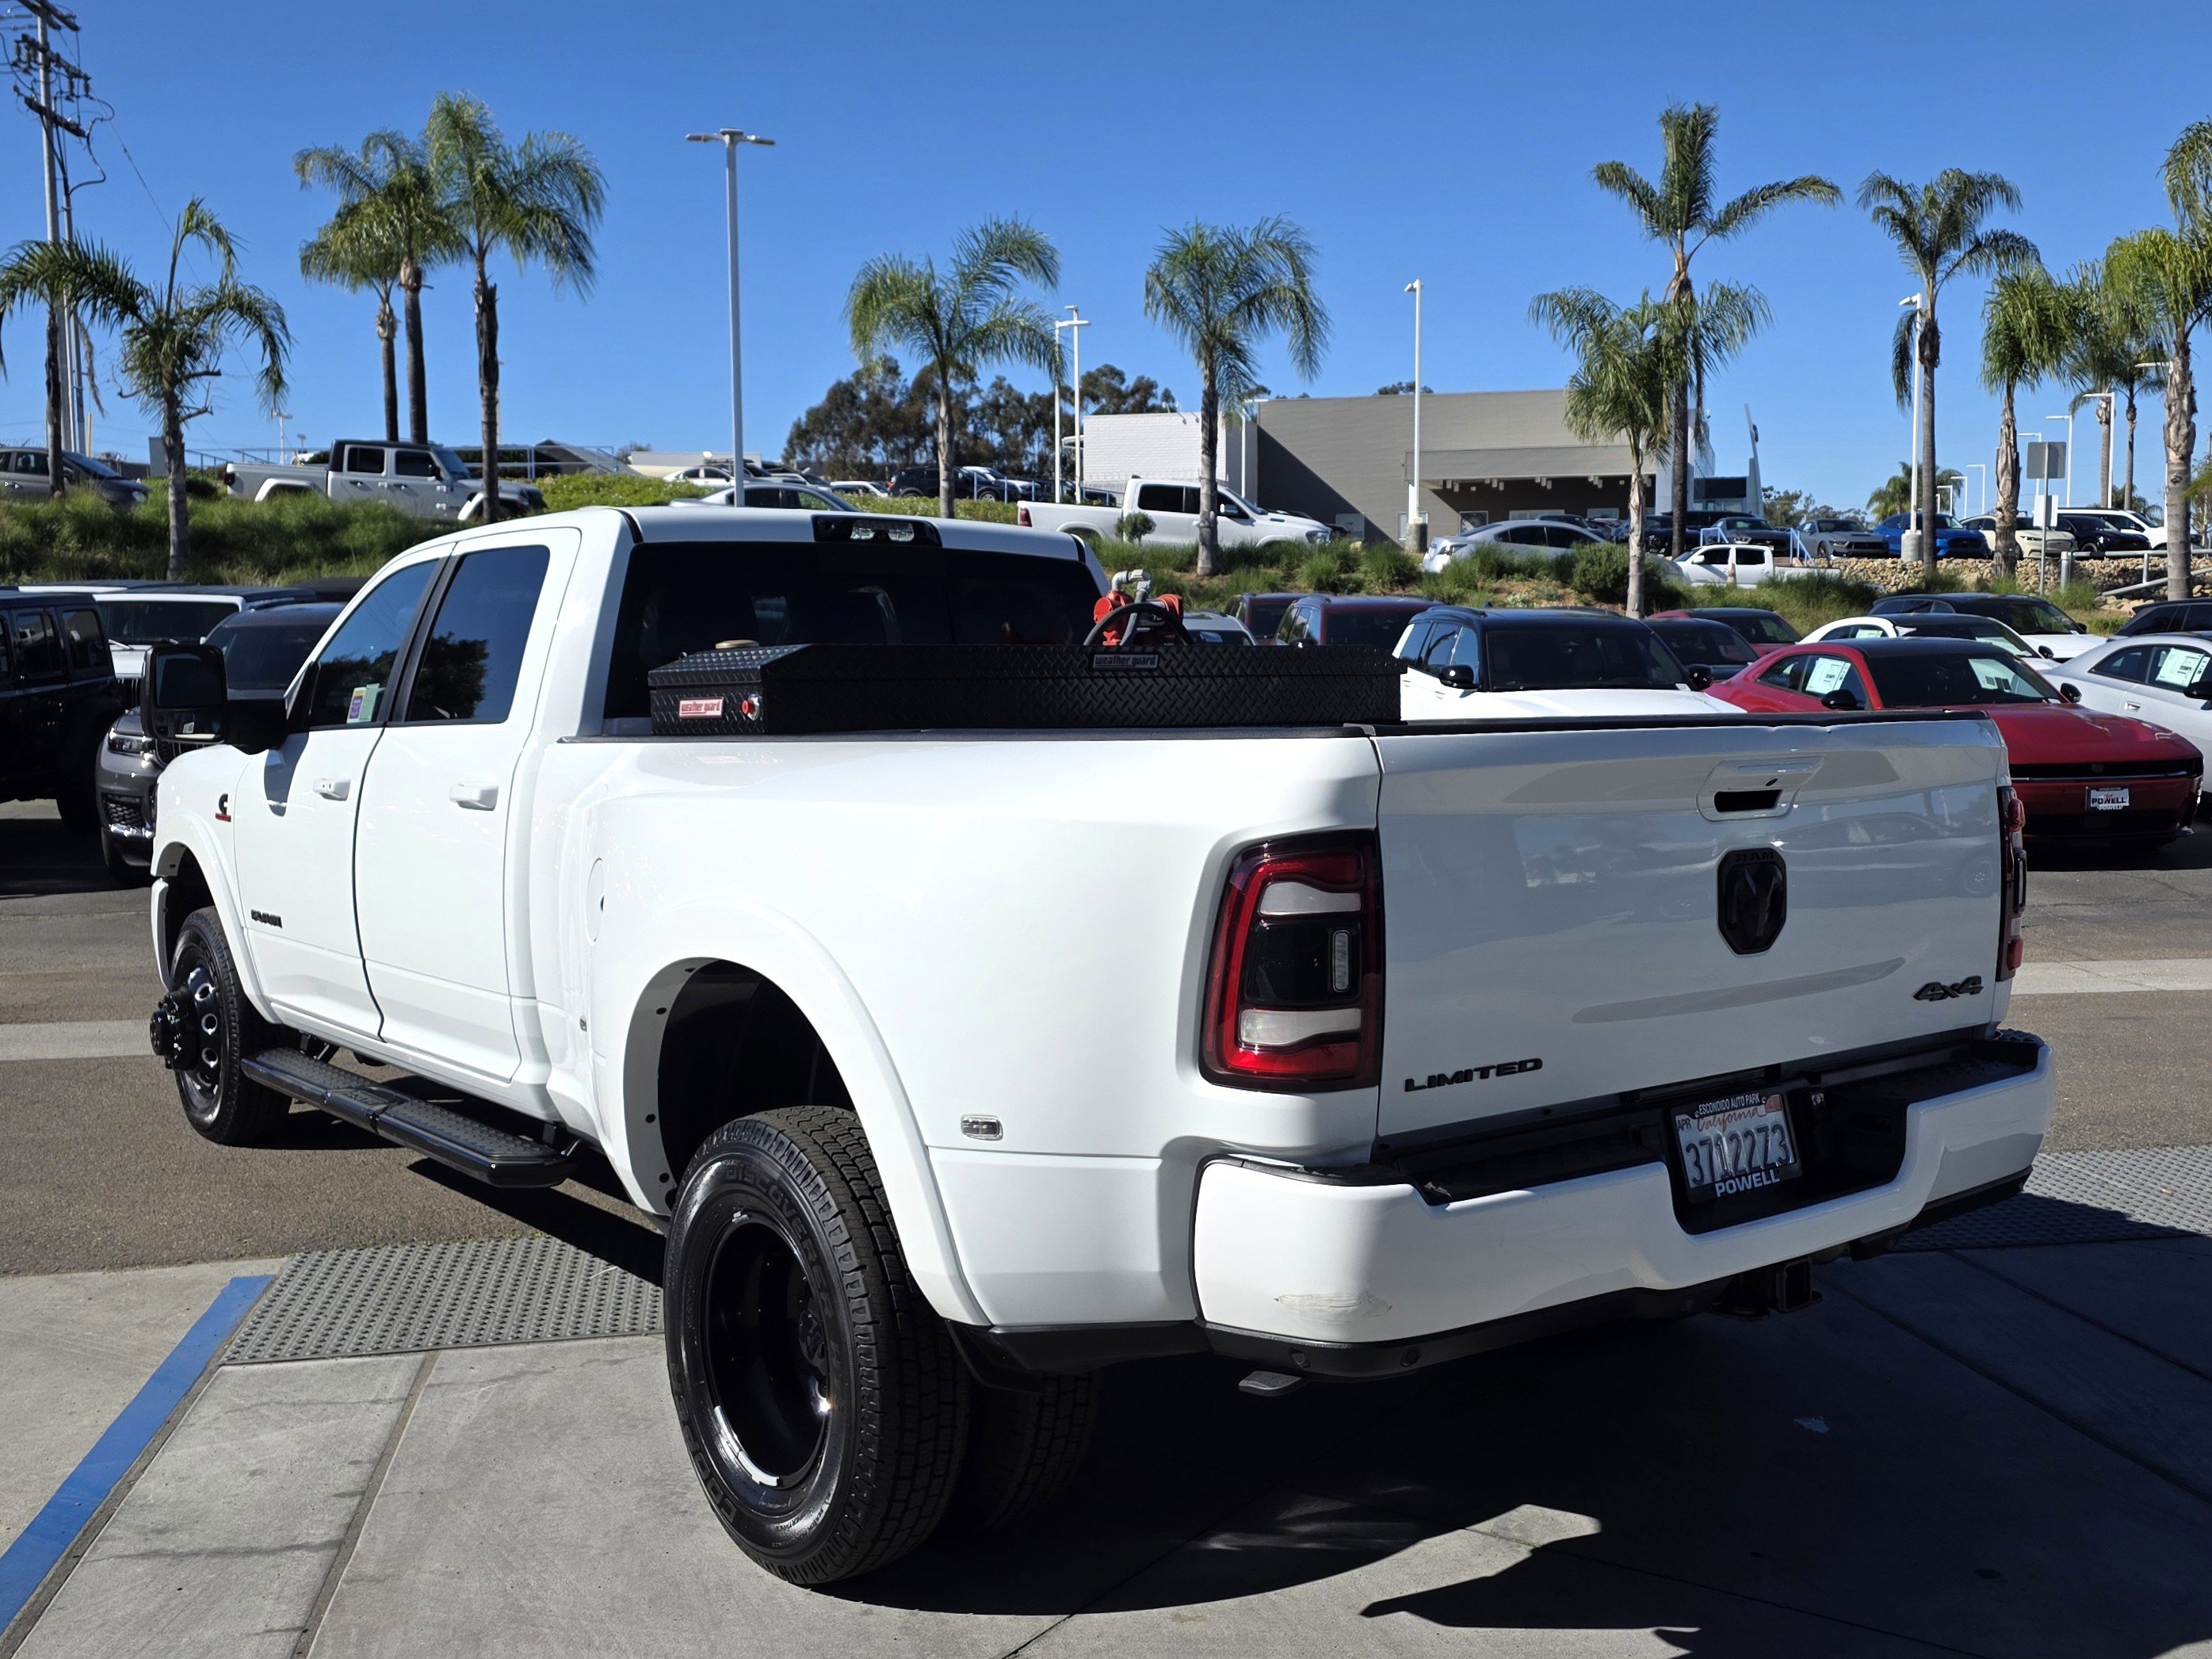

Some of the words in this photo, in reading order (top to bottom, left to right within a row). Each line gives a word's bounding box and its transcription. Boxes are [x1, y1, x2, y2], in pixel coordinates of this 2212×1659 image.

[2092, 797, 2126, 805] POWELL
[1404, 1058, 1543, 1092] LIMITED
[1698, 1098, 1730, 1115] ESCONDIDO
[1731, 1095, 1745, 1109] AUTO
[1745, 1092, 1760, 1106] PARK
[1676, 1118, 1692, 1131] APR
[1715, 1169, 1781, 1198] POWELL
